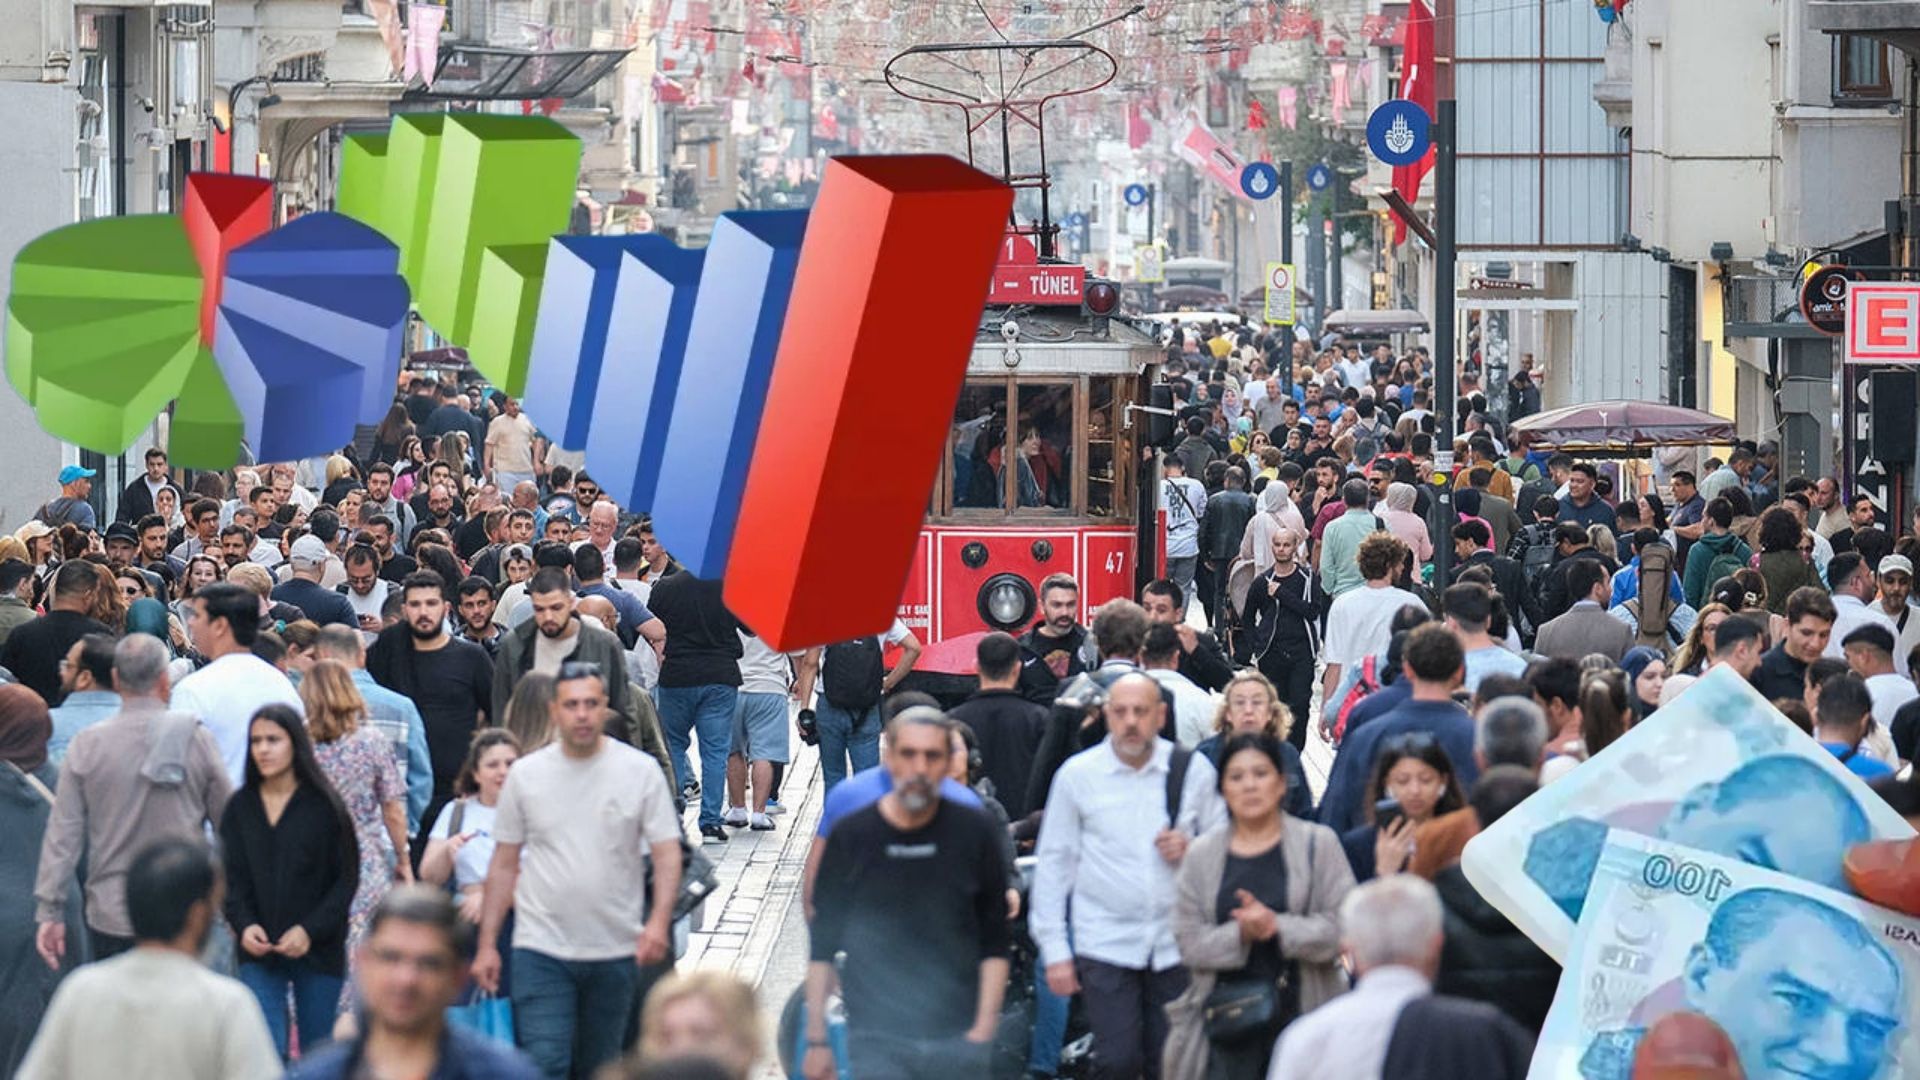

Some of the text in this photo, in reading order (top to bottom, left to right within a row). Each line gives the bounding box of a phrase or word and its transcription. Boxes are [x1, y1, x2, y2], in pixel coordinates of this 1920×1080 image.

[1006, 237, 1014, 261] 1
[1029, 270, 1079, 296] TÜNEL
[1867, 298, 1908, 346] E
[1165, 484, 1190, 496] JUT
[1105, 551, 1124, 574] 47
